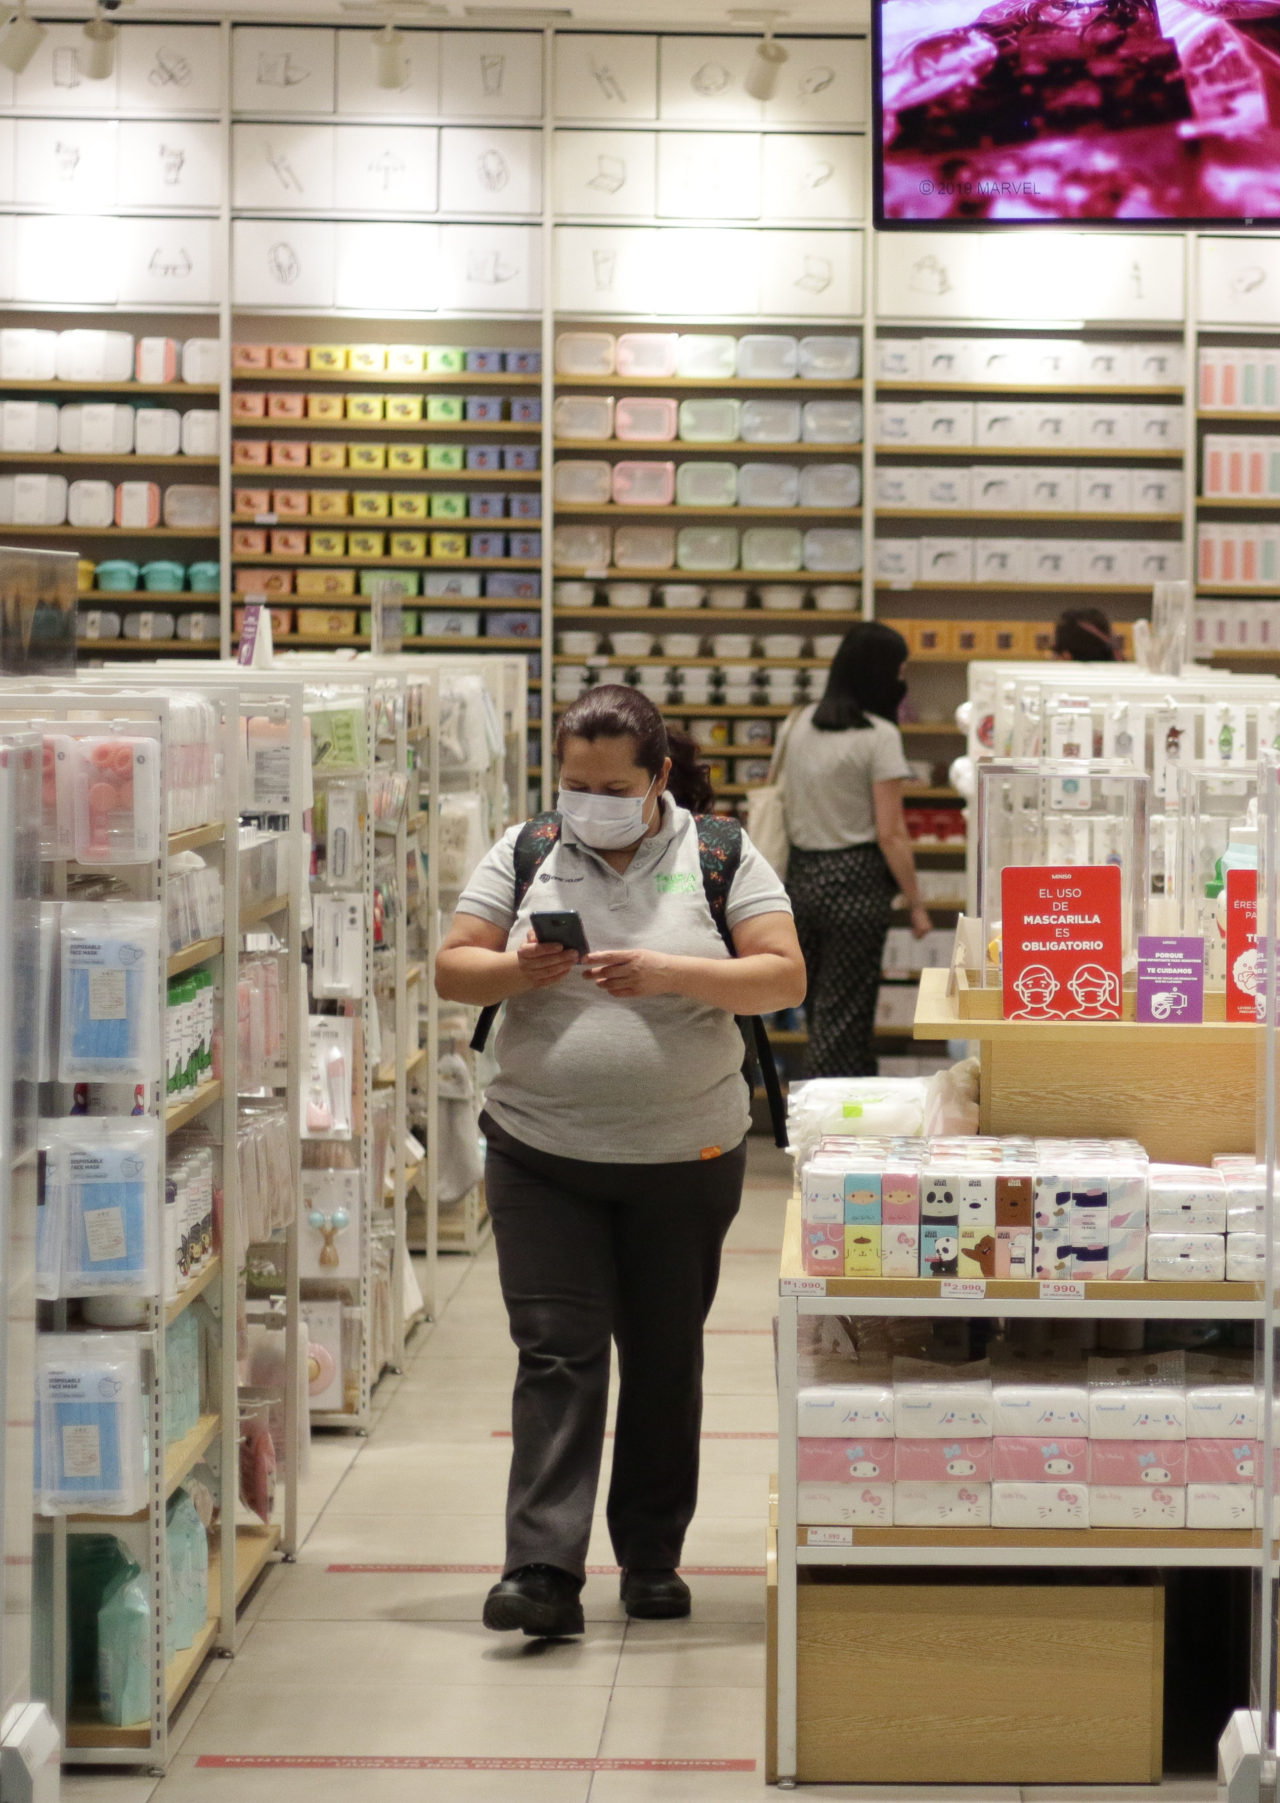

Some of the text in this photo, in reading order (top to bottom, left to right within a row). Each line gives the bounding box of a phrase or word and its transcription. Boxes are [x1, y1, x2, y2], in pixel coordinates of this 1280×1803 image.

[977, 182, 1040, 195] MARVEL
[1039, 888, 1082, 898] EL USO
[1052, 902, 1069, 911] DE
[1023, 914, 1101, 925] MASCARILLA
[1055, 928, 1070, 938] ES
[1022, 940, 1104, 951] OBLIGATORIO
